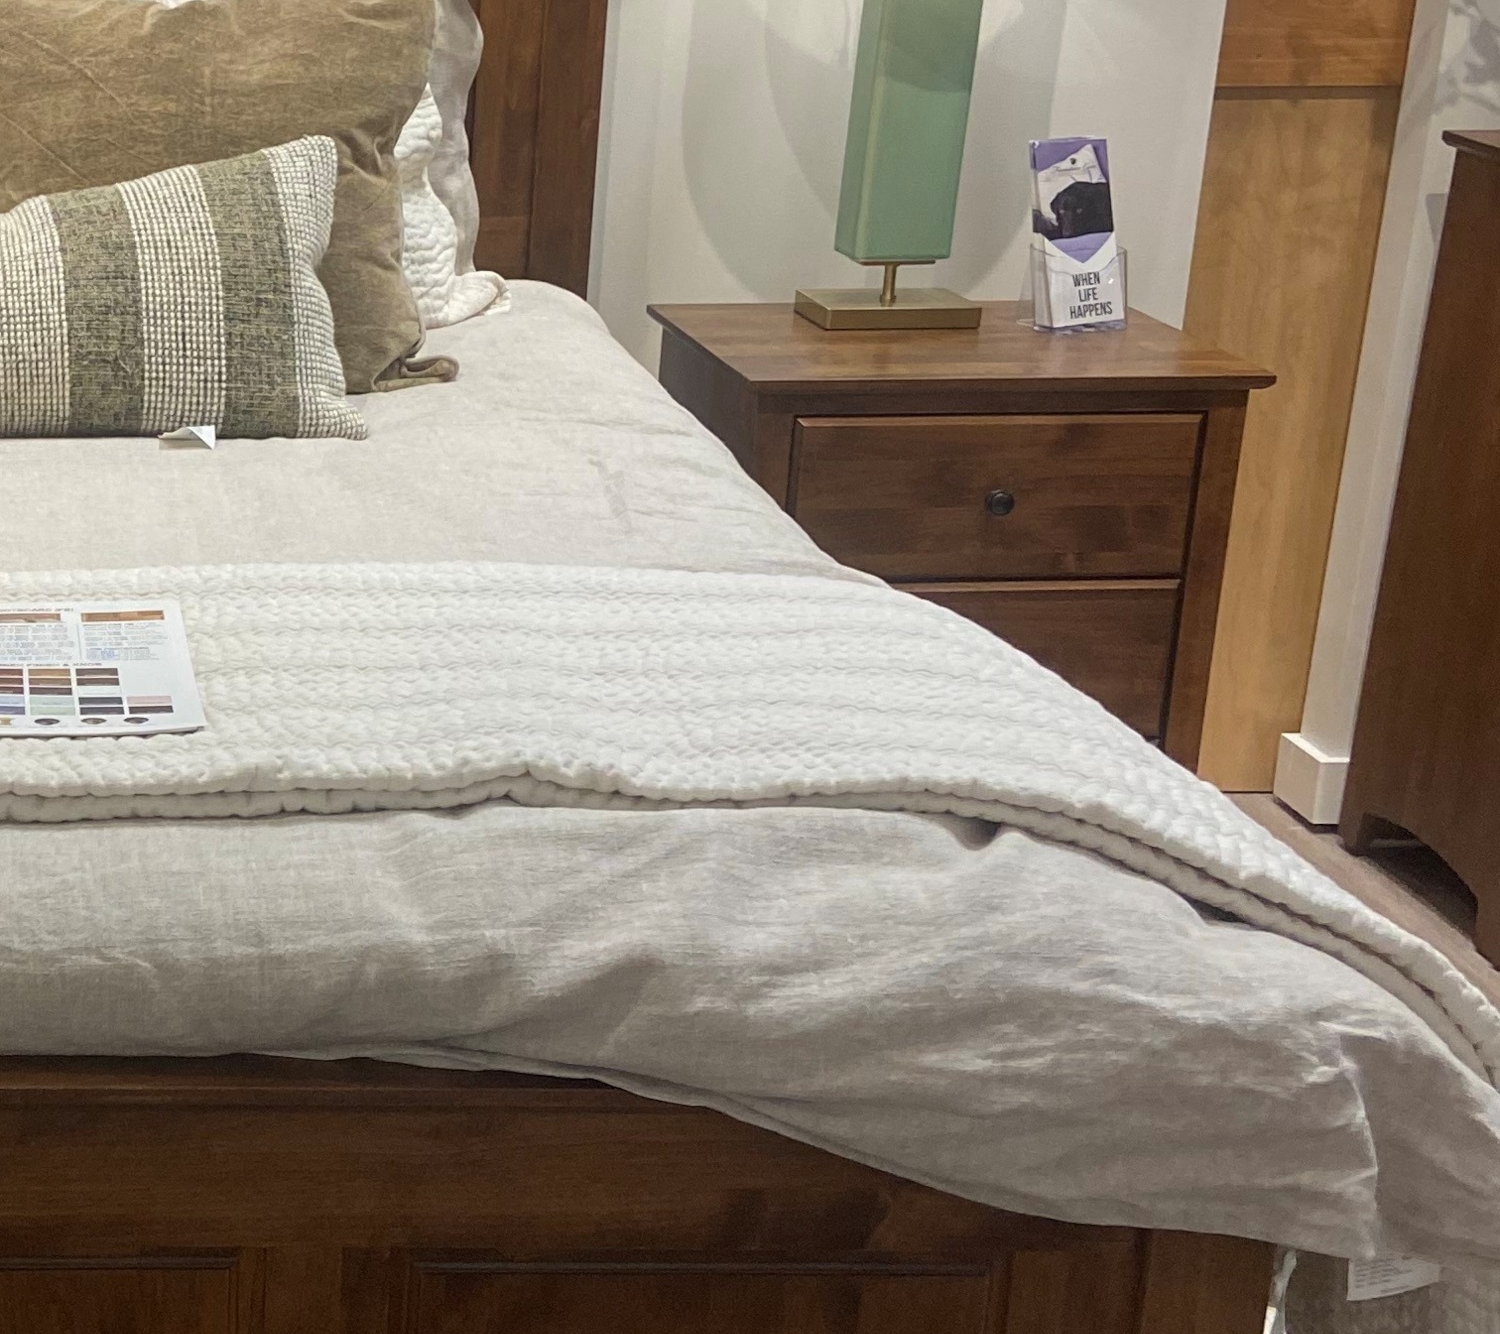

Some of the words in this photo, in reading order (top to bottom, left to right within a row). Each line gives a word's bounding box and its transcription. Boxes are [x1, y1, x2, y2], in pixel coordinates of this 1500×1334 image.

[1072, 271, 1101, 288] WHEN
[1078, 287, 1099, 303] LIFE
[1069, 302, 1113, 319] HAPPENS
